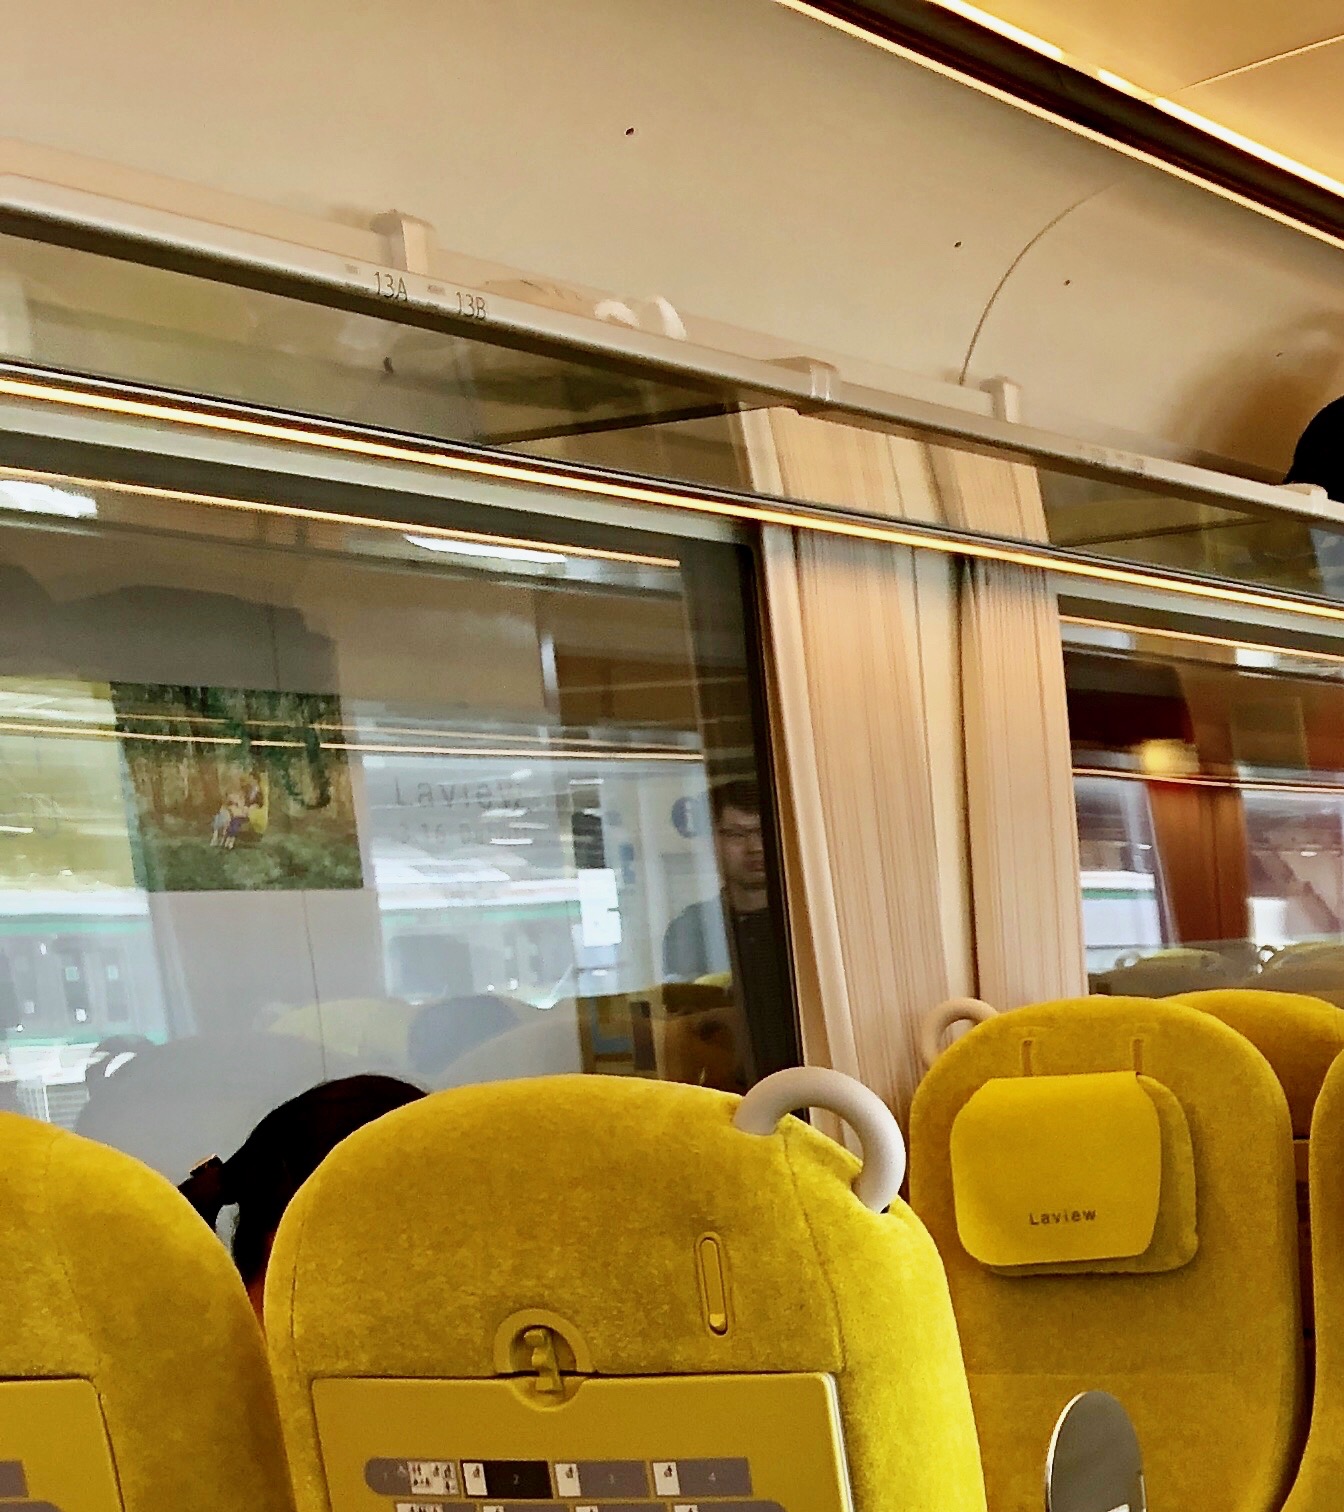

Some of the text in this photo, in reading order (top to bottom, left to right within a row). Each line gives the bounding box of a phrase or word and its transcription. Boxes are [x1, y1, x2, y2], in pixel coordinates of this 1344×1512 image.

[374, 271, 487, 320] 13A 13B
[1029, 1209, 1097, 1226] Laview
